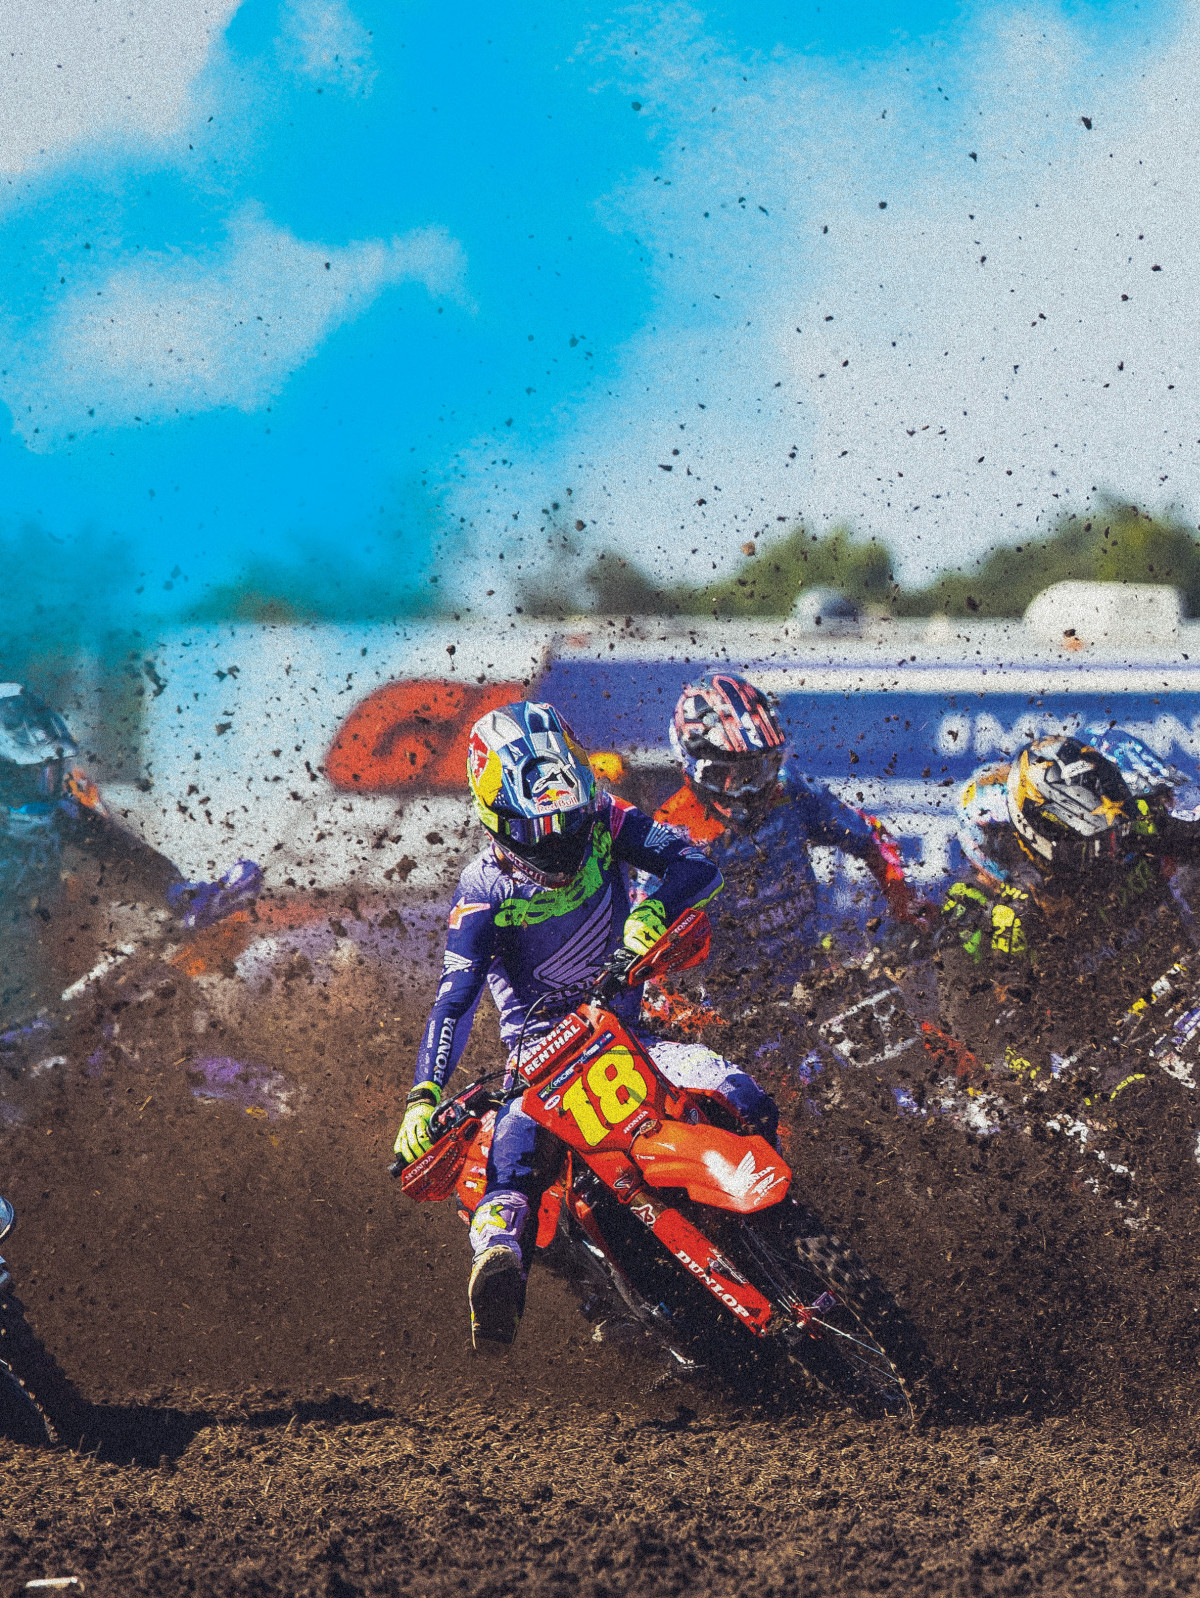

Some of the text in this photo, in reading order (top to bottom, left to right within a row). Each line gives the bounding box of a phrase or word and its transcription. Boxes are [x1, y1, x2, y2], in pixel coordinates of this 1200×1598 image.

[524, 1024, 581, 1076] RENTHAL
[562, 1045, 648, 1147] 18
[623, 1109, 649, 1135] HONDA
[675, 1249, 750, 1318] DUNLOP
